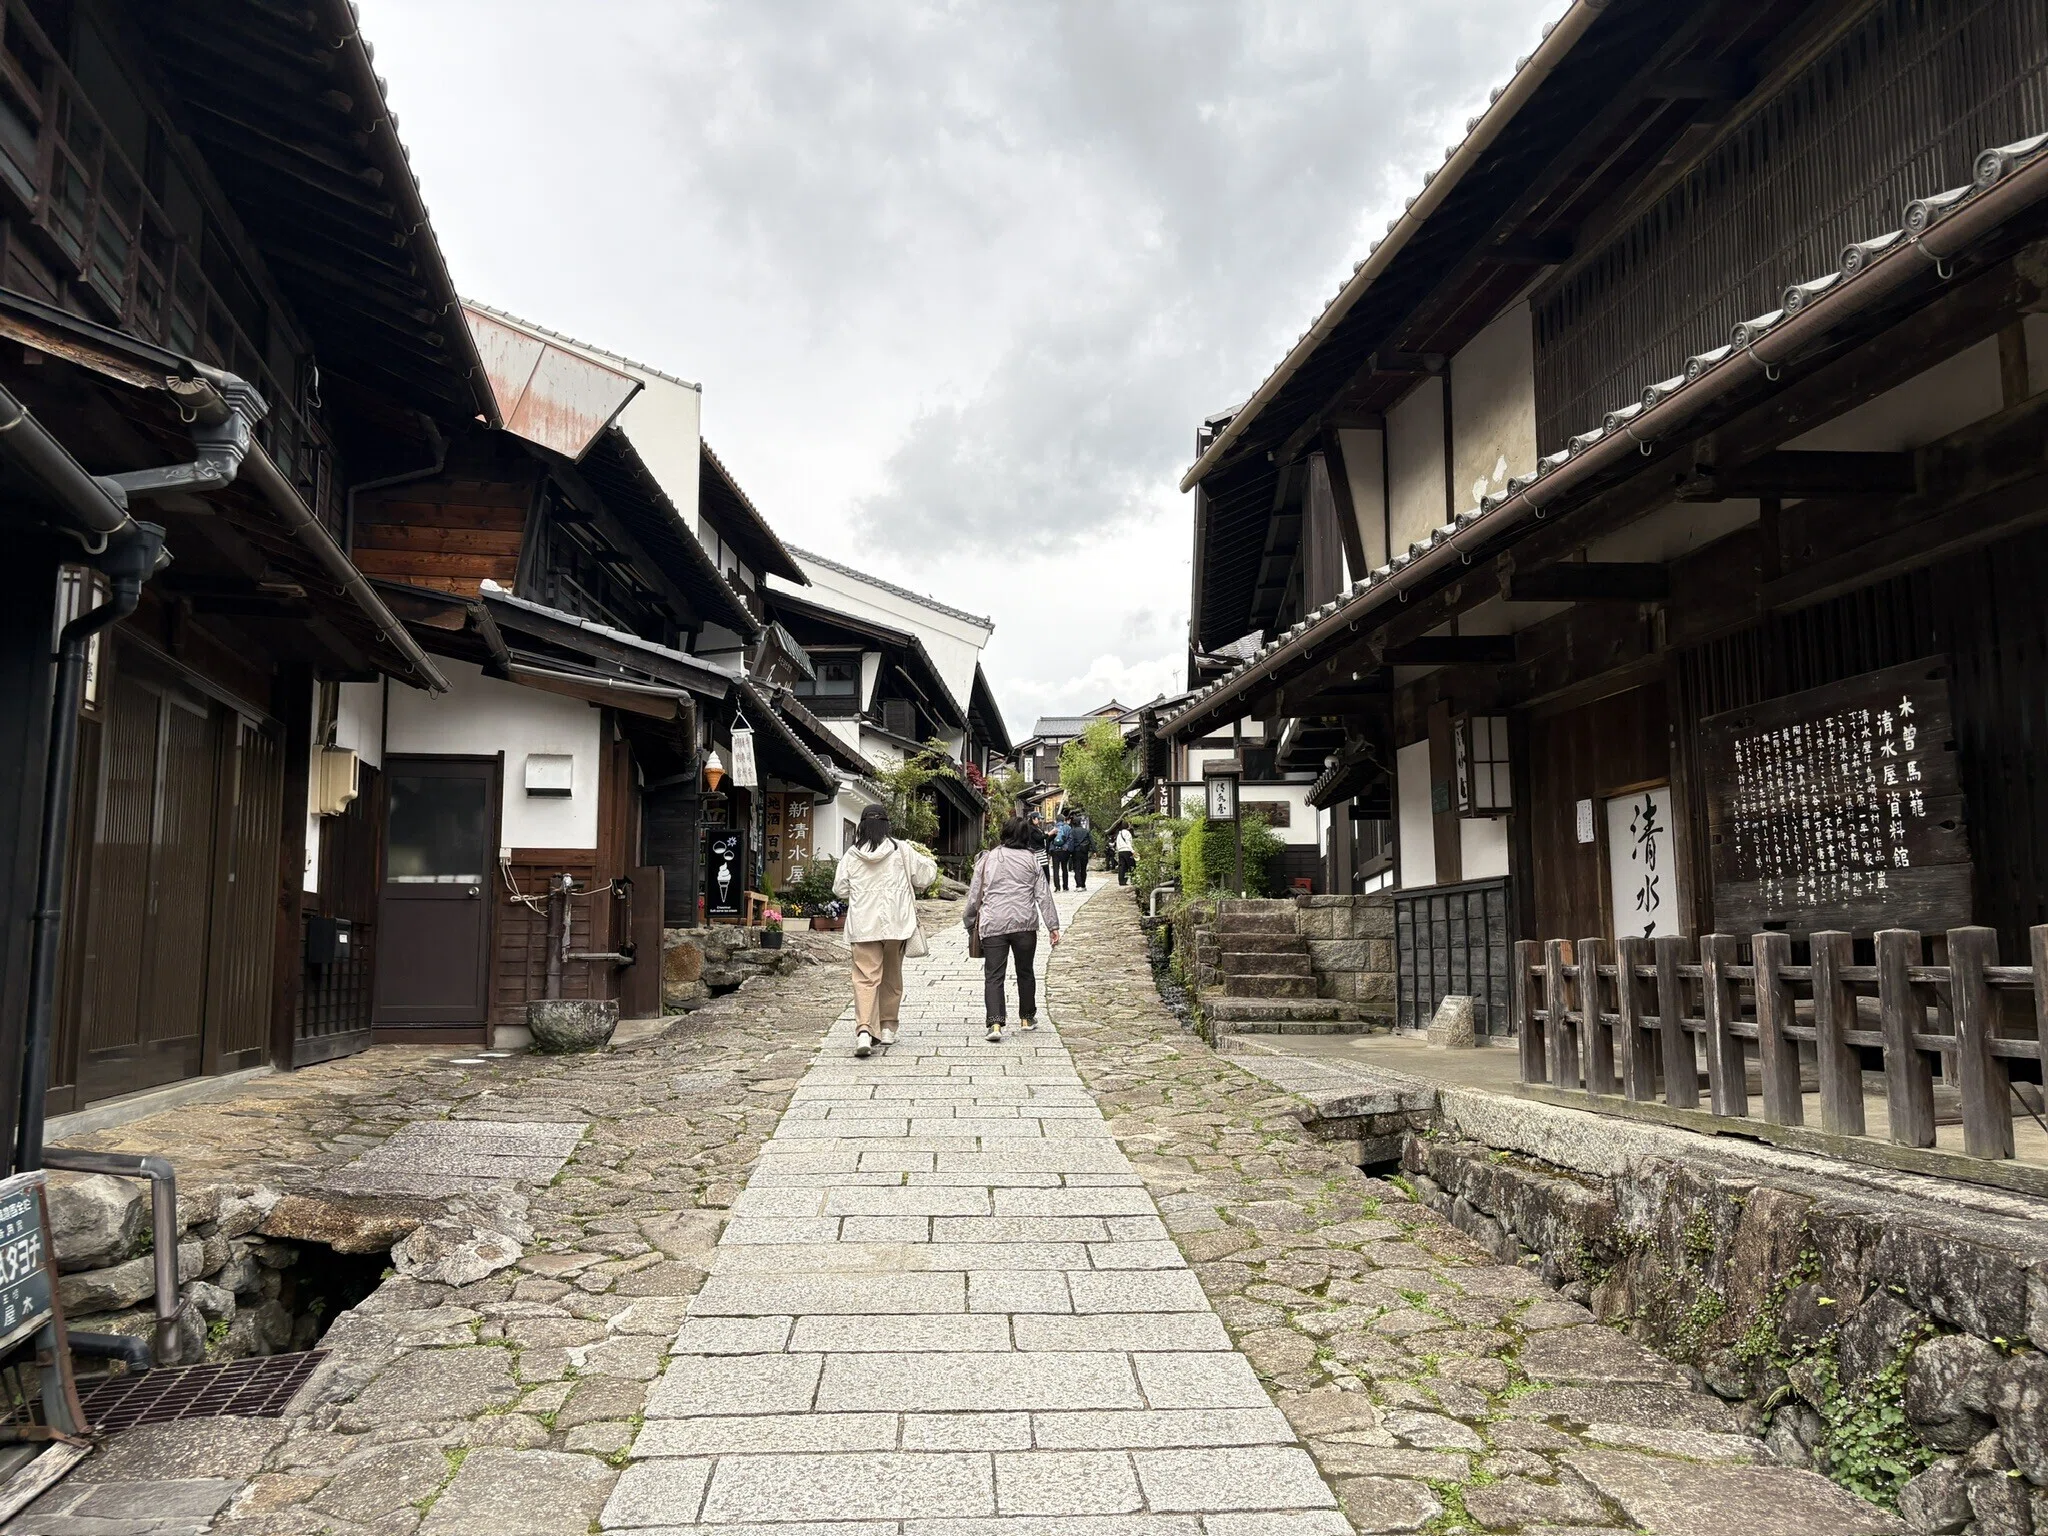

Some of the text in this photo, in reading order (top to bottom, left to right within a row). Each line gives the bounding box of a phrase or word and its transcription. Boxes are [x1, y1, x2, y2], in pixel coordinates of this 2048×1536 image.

[786, 801, 810, 884] 新清水屋
[1877, 710, 1909, 868] 清水屋資料館
[1630, 793, 1664, 939] 清水
